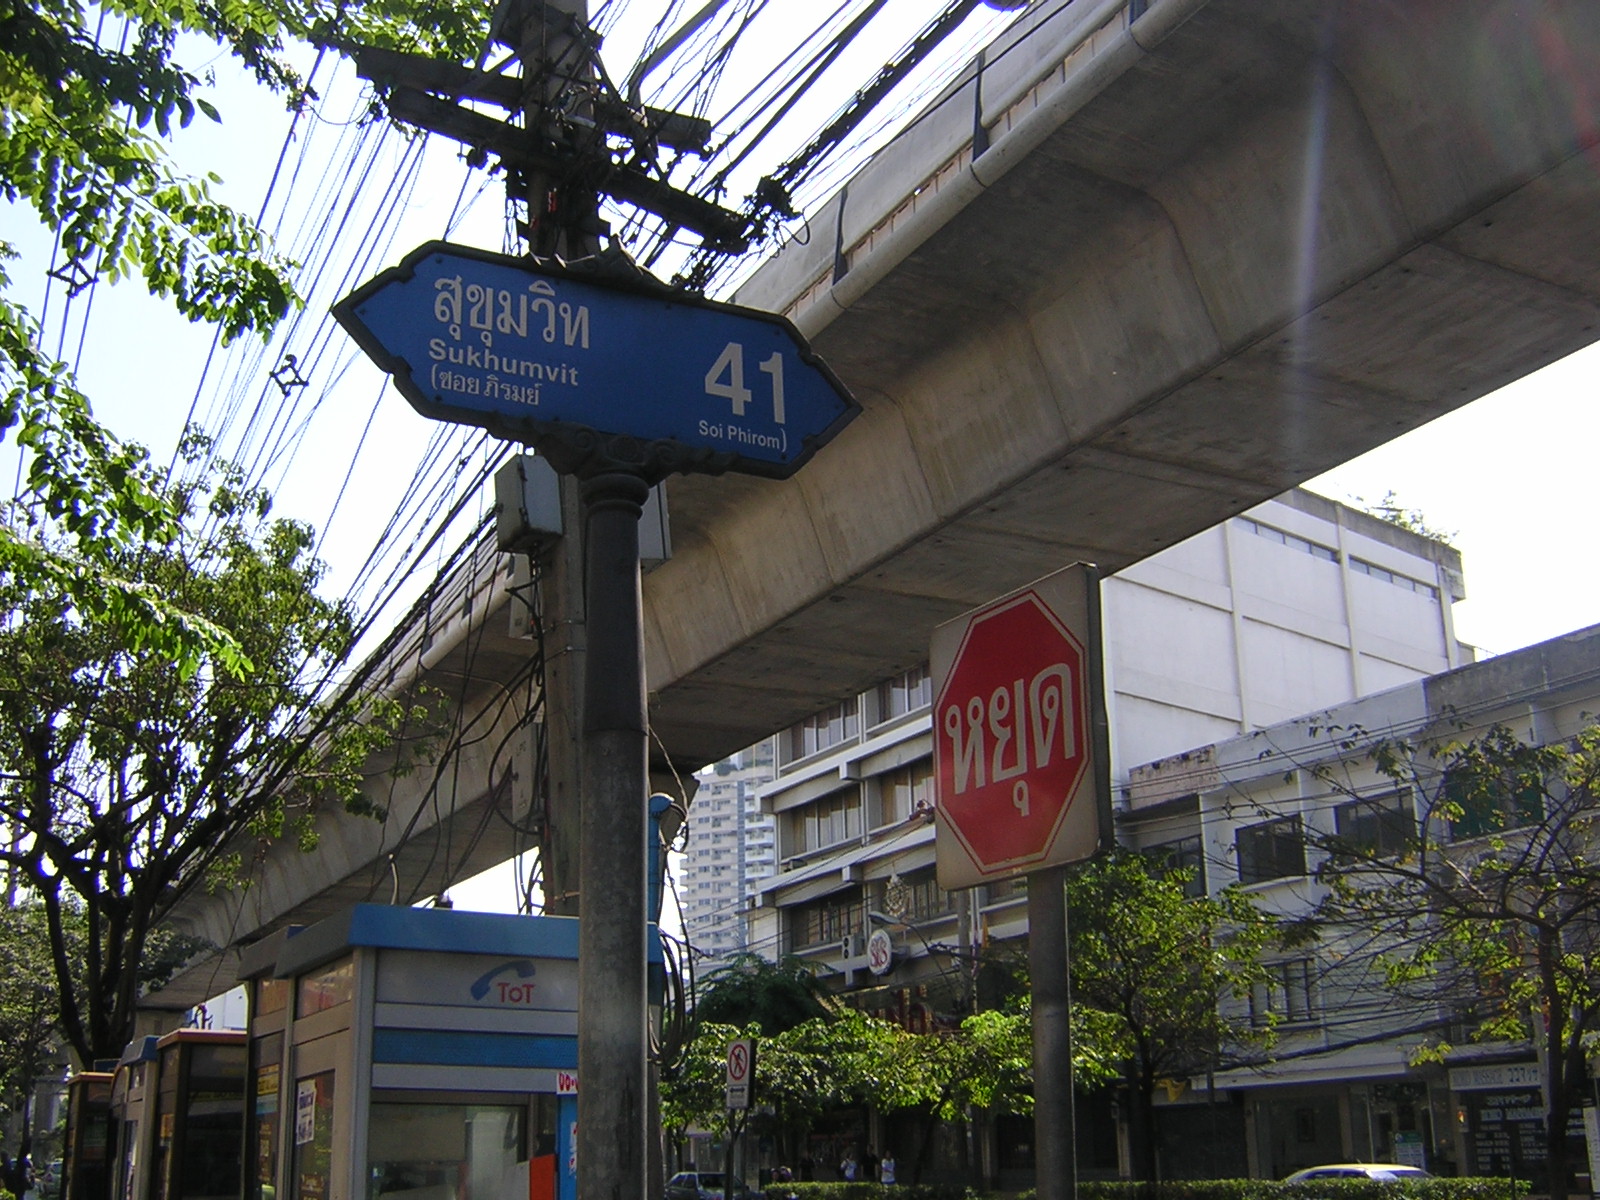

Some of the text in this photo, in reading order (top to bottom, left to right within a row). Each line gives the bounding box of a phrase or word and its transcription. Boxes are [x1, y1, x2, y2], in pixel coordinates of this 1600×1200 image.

[434, 275, 590, 349] สุขุมวิท
[429, 338, 578, 386] Sukhumvit
[483, 373, 543, 406] ภิรมย์
[705, 342, 785, 425] 41
[699, 419, 788, 453] Soi Phirom)
[945, 663, 1075, 817] หยุด
